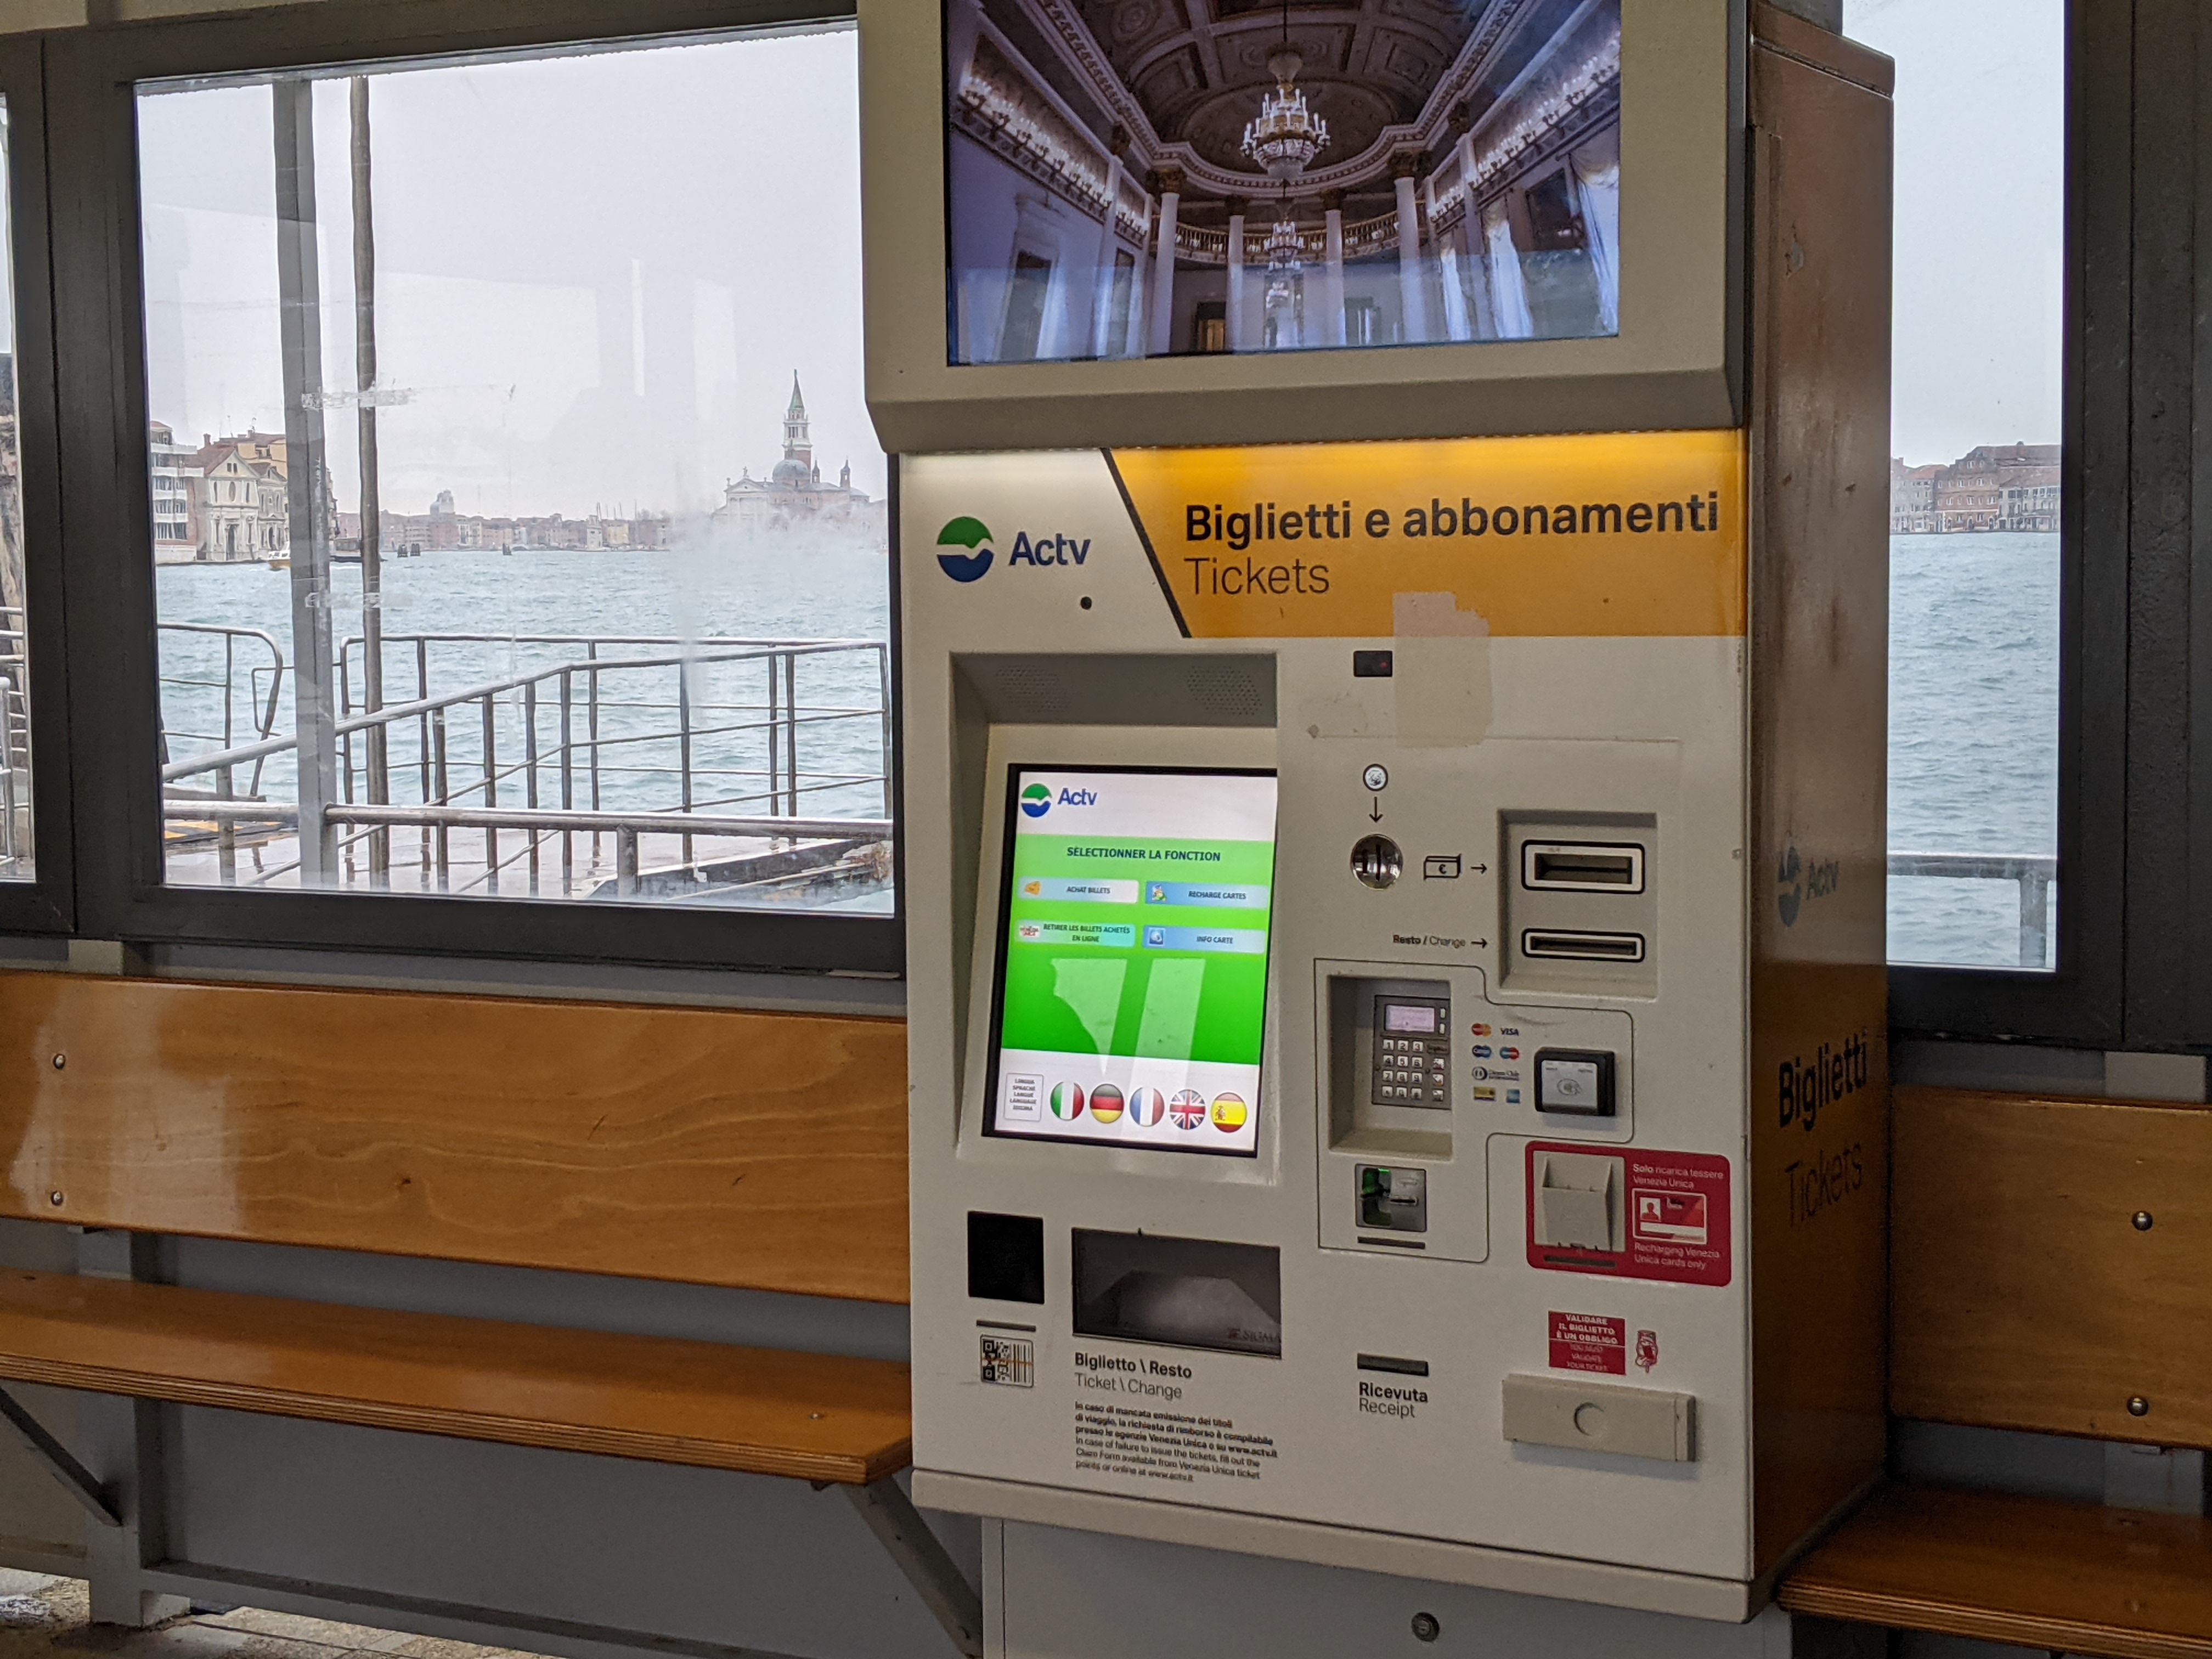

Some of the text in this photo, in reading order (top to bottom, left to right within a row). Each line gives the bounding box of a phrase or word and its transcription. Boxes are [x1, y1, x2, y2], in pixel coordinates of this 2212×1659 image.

[1185, 491, 1718, 550] Biglietti e abbonamenti
[1009, 532, 1091, 566] Actv
[1183, 557, 1330, 595] Tickets
[1058, 787, 1097, 806] Actv
[1149, 850, 1161, 859] LA
[1165, 850, 1220, 861] FONCTION
[1393, 935, 1421, 945] Resto
[1500, 1027, 1519, 1036] VISA
[1779, 1030, 1867, 1132] Biglietti
[1633, 1163, 1724, 1180] Solo ricarica tessere
[1633, 1175, 1694, 1189] Venezia Unica
[1785, 1142, 1863, 1228] Tickets
[1635, 1254, 1660, 1265] Unica
[1661, 1257, 1686, 1267] cards
[1685, 1247, 1720, 1258] Venezia
[1565, 1314, 1608, 1325] VALIDARE
[1569, 1323, 1615, 1335] BIGLIETTO
[1564, 1332, 1577, 1340] UN
[1579, 1334, 1618, 1344] OBBLIGO
[1075, 1351, 1192, 1379] Biglietto \ Resto
[1074, 1372, 1116, 1391] Ticket
[1128, 1378, 1182, 1400] Change
[1359, 1381, 1428, 1403] Ricevuta
[1075, 1401, 1084, 1410] In
[1085, 1403, 1104, 1412] caso
[1116, 1407, 1151, 1418] mancata
[1153, 1412, 1195, 1423] emissione
[1359, 1397, 1415, 1419] Receipt
[1075, 1413, 1083, 1421] di
[1119, 1418, 1126, 1426] la
[1128, 1419, 1164, 1431] richiesta
[1166, 1424, 1174, 1432] di
[1076, 1426, 1103, 1436] presso
[1105, 1428, 1113, 1436] le
[1115, 1430, 1147, 1441] agenzie
[1149, 1432, 1181, 1445] Venezia
[1183, 1437, 1207, 1448] Unica
[1076, 1436, 1083, 1445] In
[1085, 1438, 1103, 1447] case
[1105, 1440, 1113, 1448] of
[1115, 1441, 1139, 1452] failure
[1141, 1444, 1149, 1453] to
[1151, 1446, 1172, 1456] issue
[1174, 1448, 1187, 1458] the
[1231, 1457, 1244, 1466] out
[1099, 1449, 1120, 1461] Form
[1159, 1458, 1177, 1468] from
[1179, 1460, 1210, 1472] Venezia
[1211, 1465, 1235, 1476] Unica
[1237, 1468, 1260, 1480] ticket
